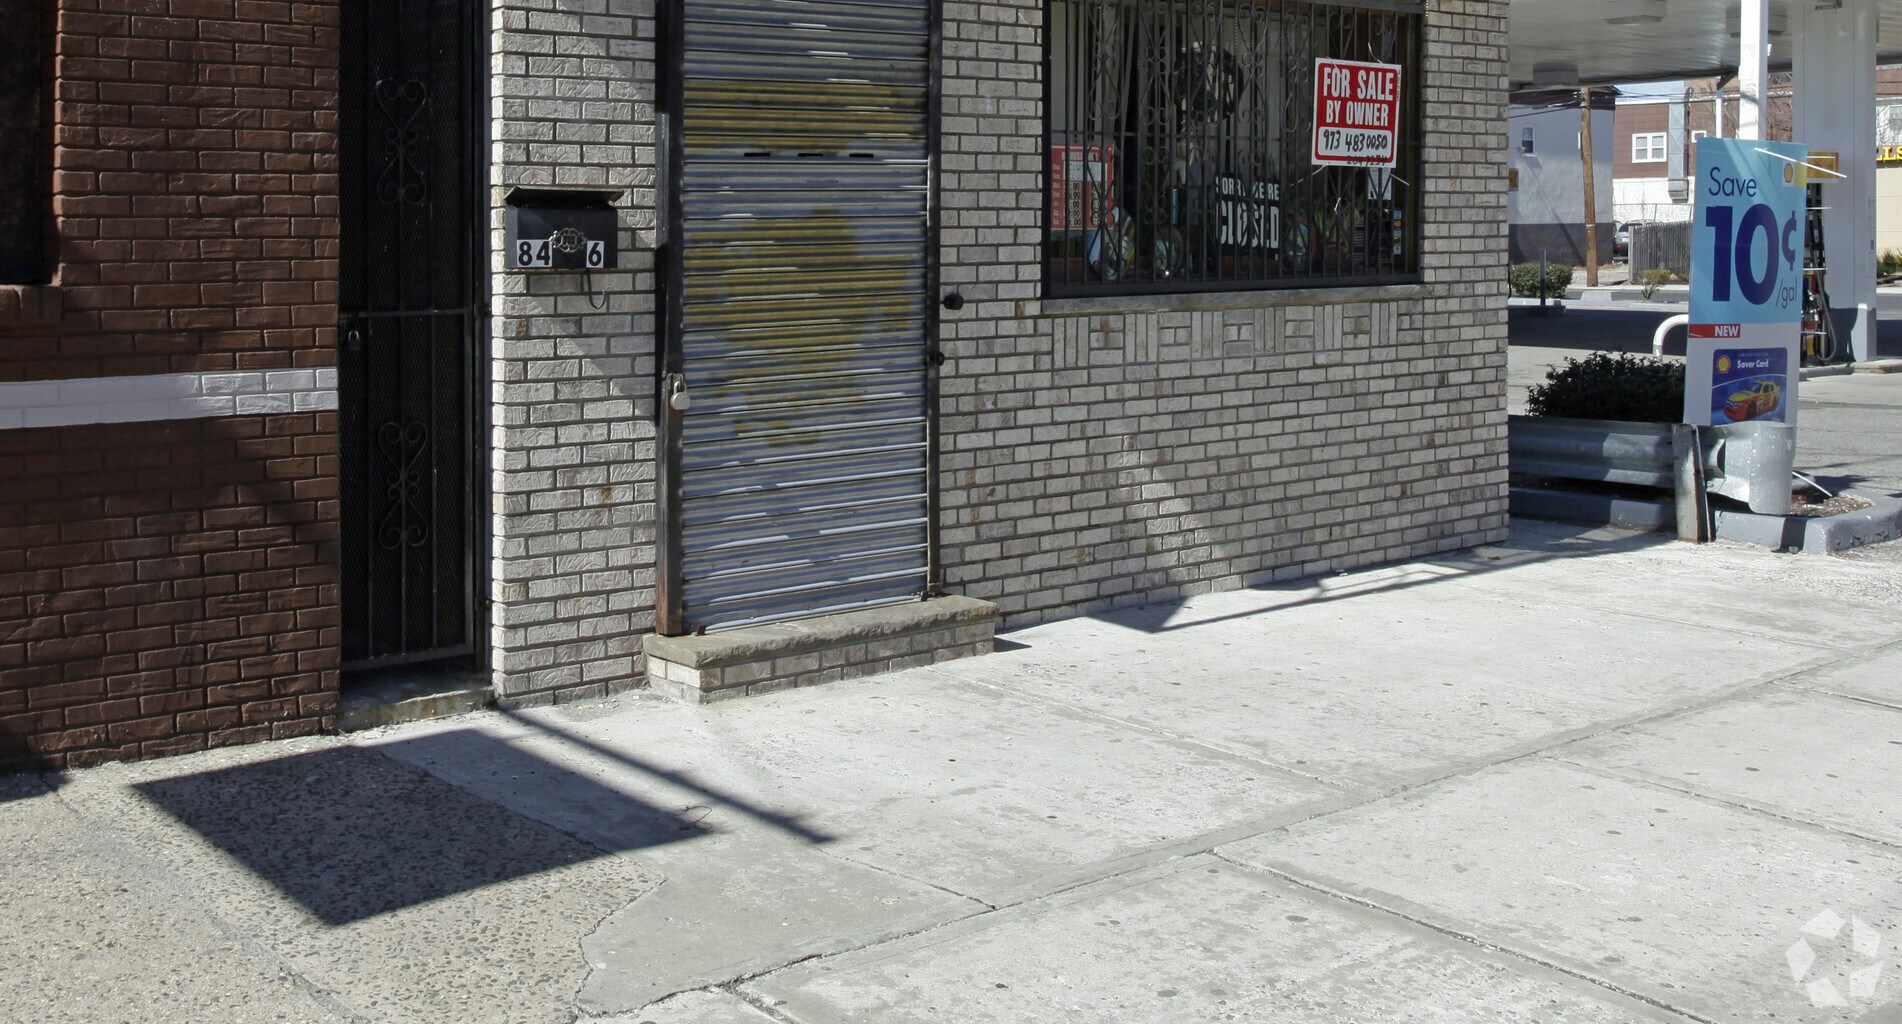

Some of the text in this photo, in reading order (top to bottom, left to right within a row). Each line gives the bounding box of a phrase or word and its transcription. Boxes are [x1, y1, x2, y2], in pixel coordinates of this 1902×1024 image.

[1323, 67, 1351, 98] FOR
[1357, 69, 1394, 101] SALE
[1326, 99, 1389, 127] BY OWNER
[1323, 129, 1341, 151] 973
[1708, 167, 1757, 197] Save
[1775, 279, 1798, 309] /gal
[1714, 325, 1739, 337] NEW
[1737, 359, 1769, 369] Saver Card
